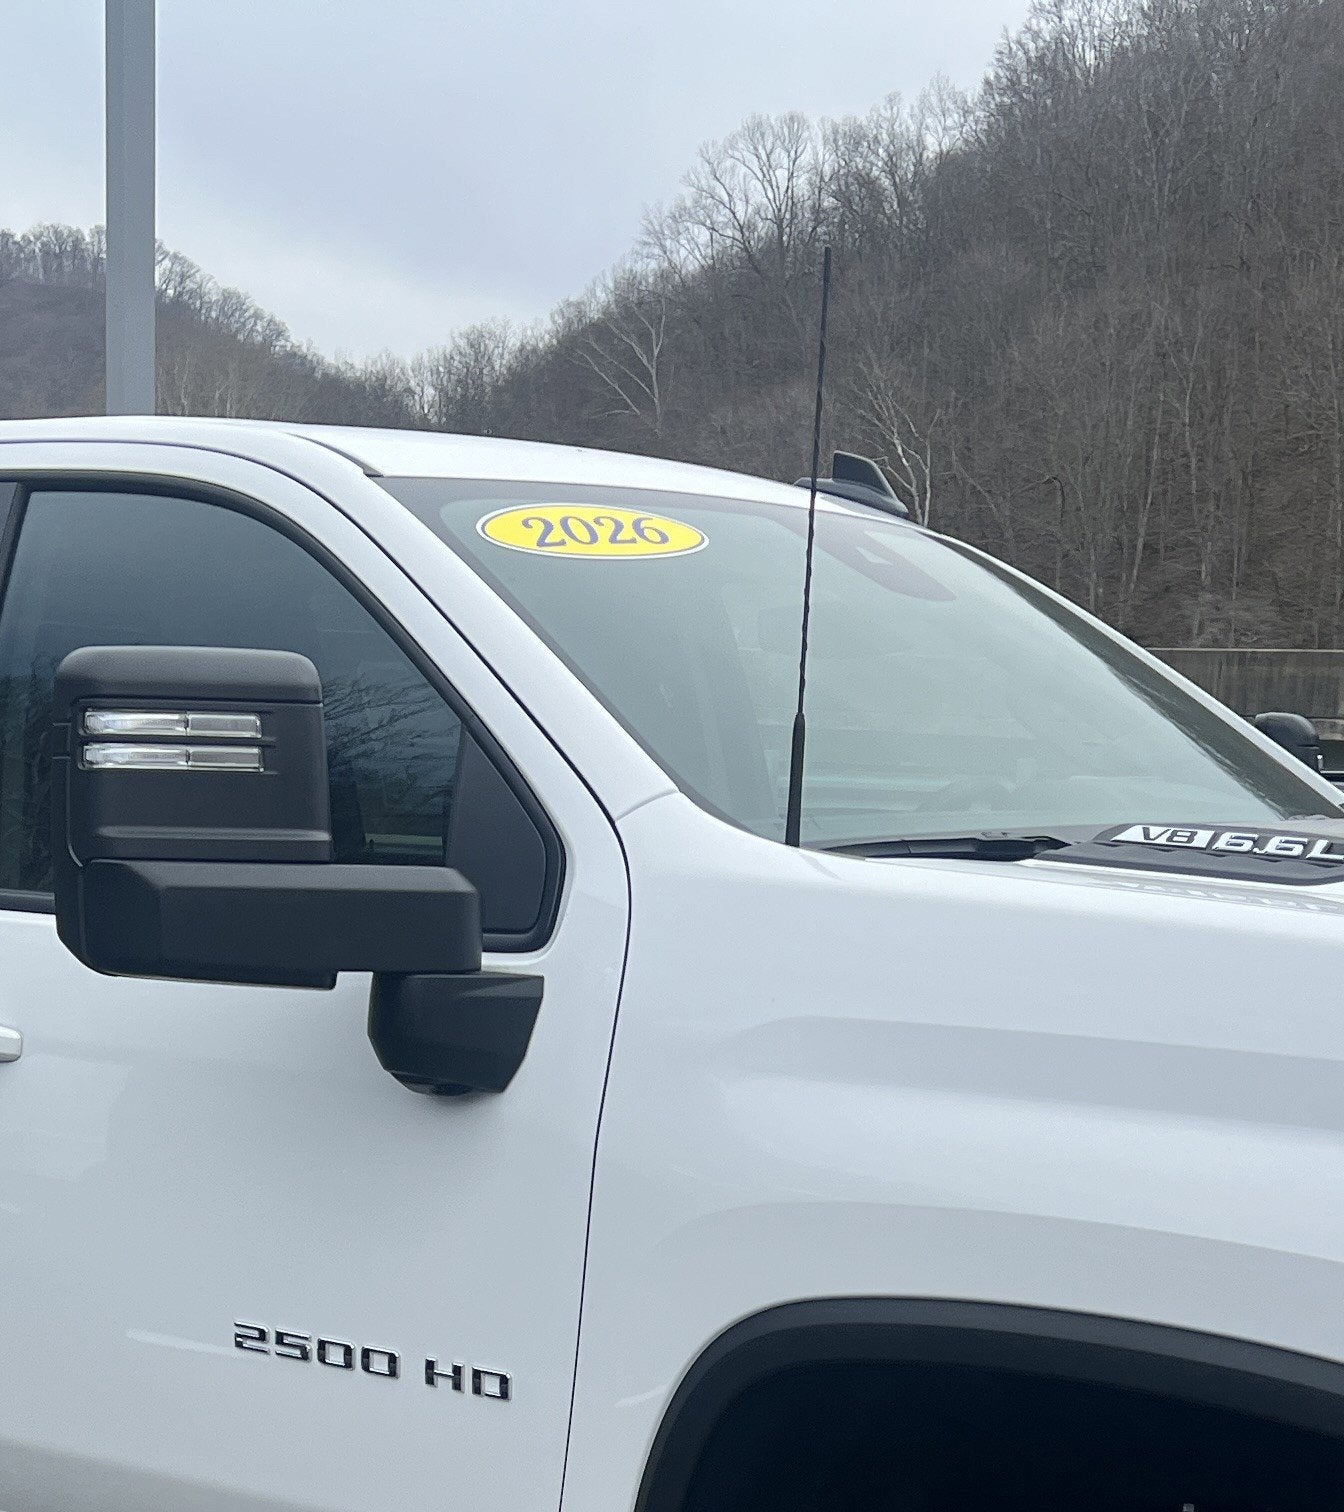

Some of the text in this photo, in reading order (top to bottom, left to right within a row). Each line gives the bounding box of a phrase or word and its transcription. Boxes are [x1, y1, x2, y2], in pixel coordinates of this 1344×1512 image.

[521, 515, 670, 548] 2026
[1141, 825, 1198, 845] V8
[233, 1320, 513, 1401] 2500 HD
